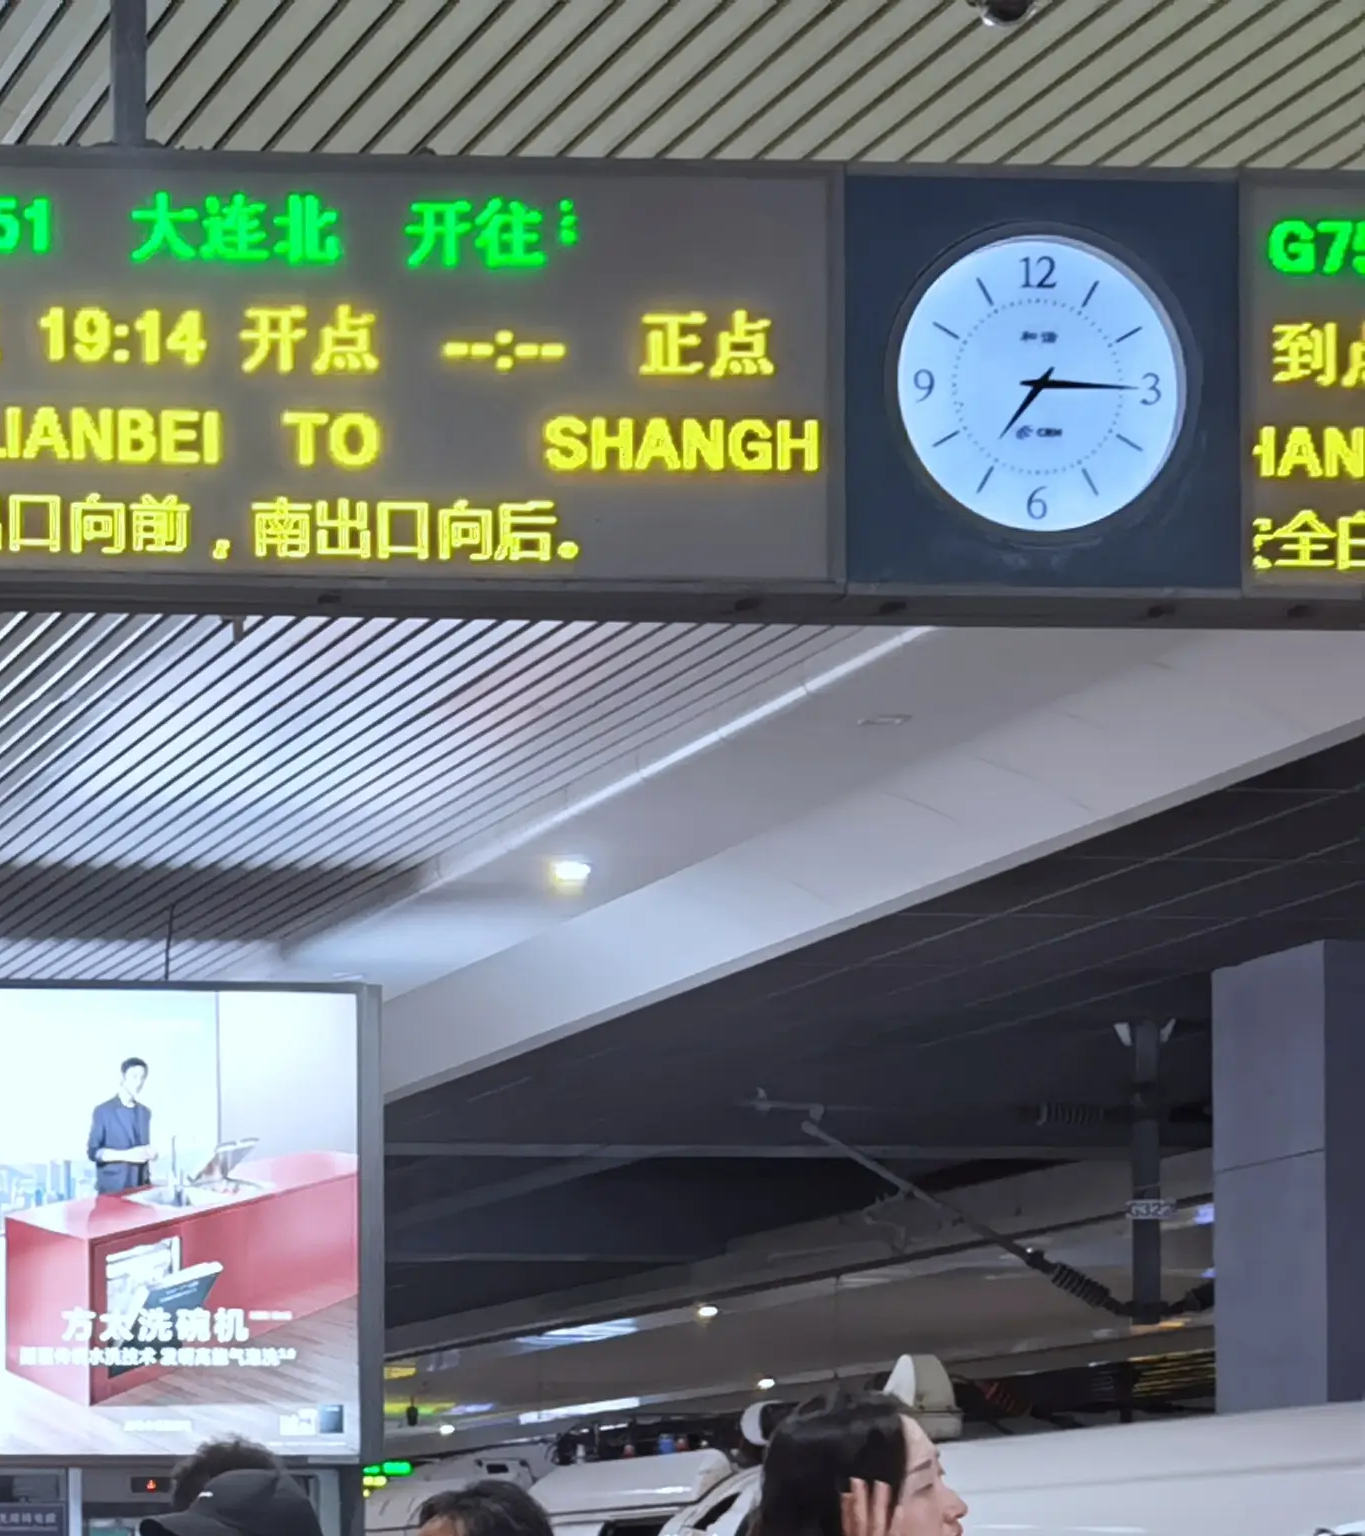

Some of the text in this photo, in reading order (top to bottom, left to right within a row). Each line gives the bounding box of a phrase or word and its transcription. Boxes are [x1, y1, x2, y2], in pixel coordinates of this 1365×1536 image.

[130, 191, 344, 268] 大连北
[404, 197, 579, 270] 开往
[1019, 255, 1057, 289] 12
[39, 305, 208, 367] 19:14
[238, 303, 380, 376] 开点
[638, 309, 775, 379] 正点
[913, 369, 936, 402] 9
[1140, 371, 1163, 406] 3
[282, 410, 382, 471] TO
[542, 415, 819, 472] SHANGH
[1025, 485, 1048, 520] 6
[60, 1305, 251, 1343] 方太洗碗机
